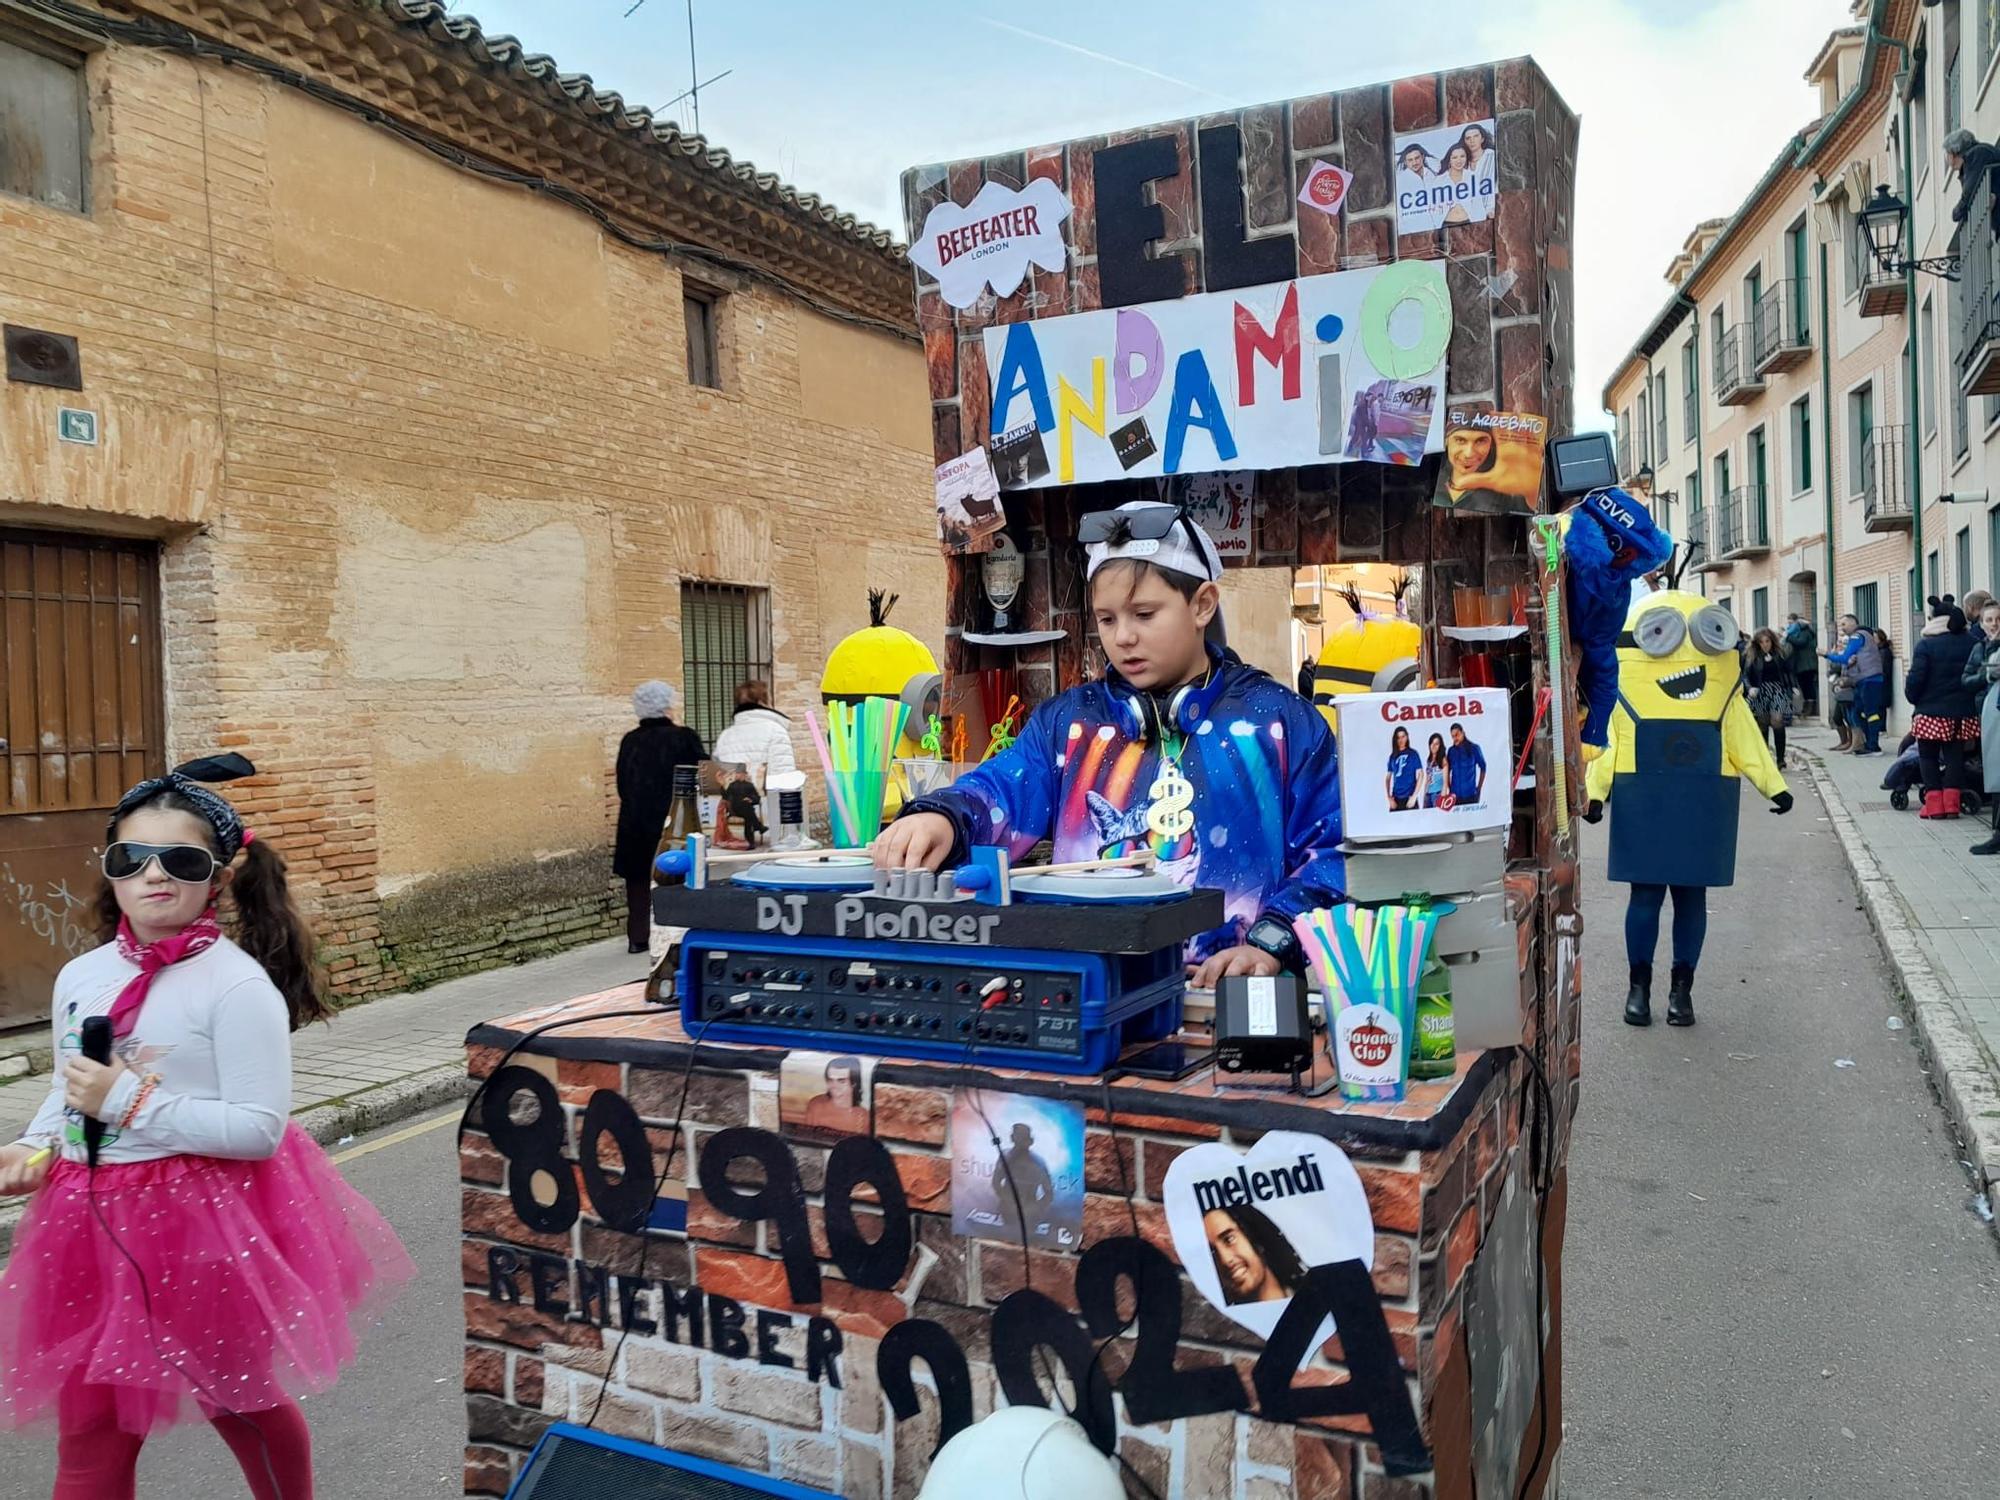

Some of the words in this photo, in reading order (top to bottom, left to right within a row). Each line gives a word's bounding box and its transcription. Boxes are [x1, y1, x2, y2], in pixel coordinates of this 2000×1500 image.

[1400, 174, 1492, 209] camela
[1093, 123, 1298, 309] EL
[937, 205, 1041, 267] BEEFEATER
[971, 242, 1010, 260] LONDON
[1452, 412, 1468, 426] EL
[1471, 413, 1545, 433] ARREBATO
[1381, 695, 1484, 722] Camela
[1440, 798, 1454, 809] 10
[757, 894, 808, 936] DJ
[1037, 1016, 1078, 1032] FBT
[1353, 1044, 1387, 1060] Club
[482, 1065, 655, 1234] 80
[700, 1126, 912, 1304] 90
[1192, 1153, 1325, 1216] melendi
[488, 1246, 843, 1389] REMEMBER
